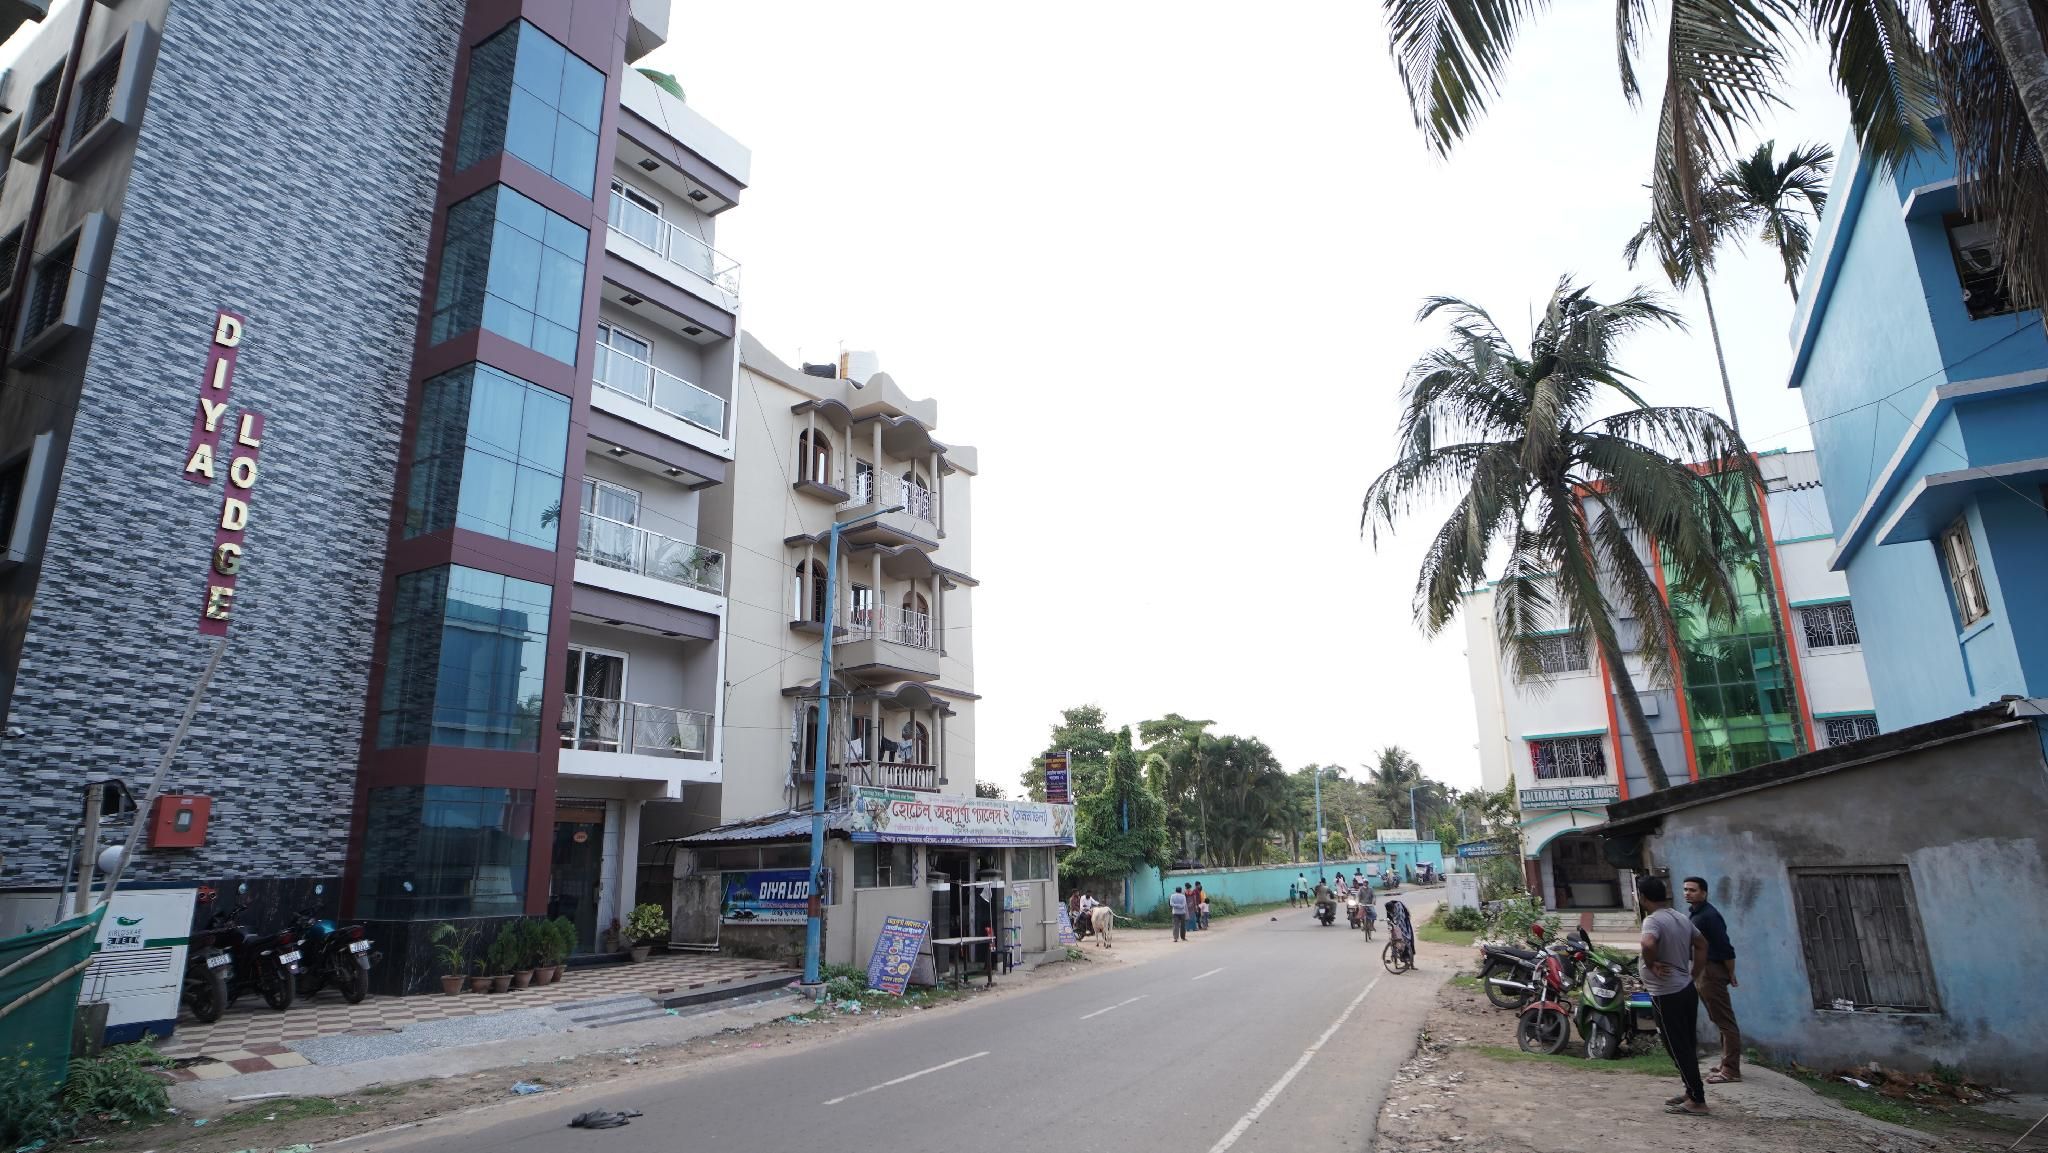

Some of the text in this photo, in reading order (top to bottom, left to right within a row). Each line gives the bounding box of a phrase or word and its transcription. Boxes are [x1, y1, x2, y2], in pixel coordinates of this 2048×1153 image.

[185, 313, 243, 479] DIYA
[205, 413, 261, 620] LODGE
[1569, 788, 1593, 800] GUEST
[759, 881, 810, 900] DIYA LOD
